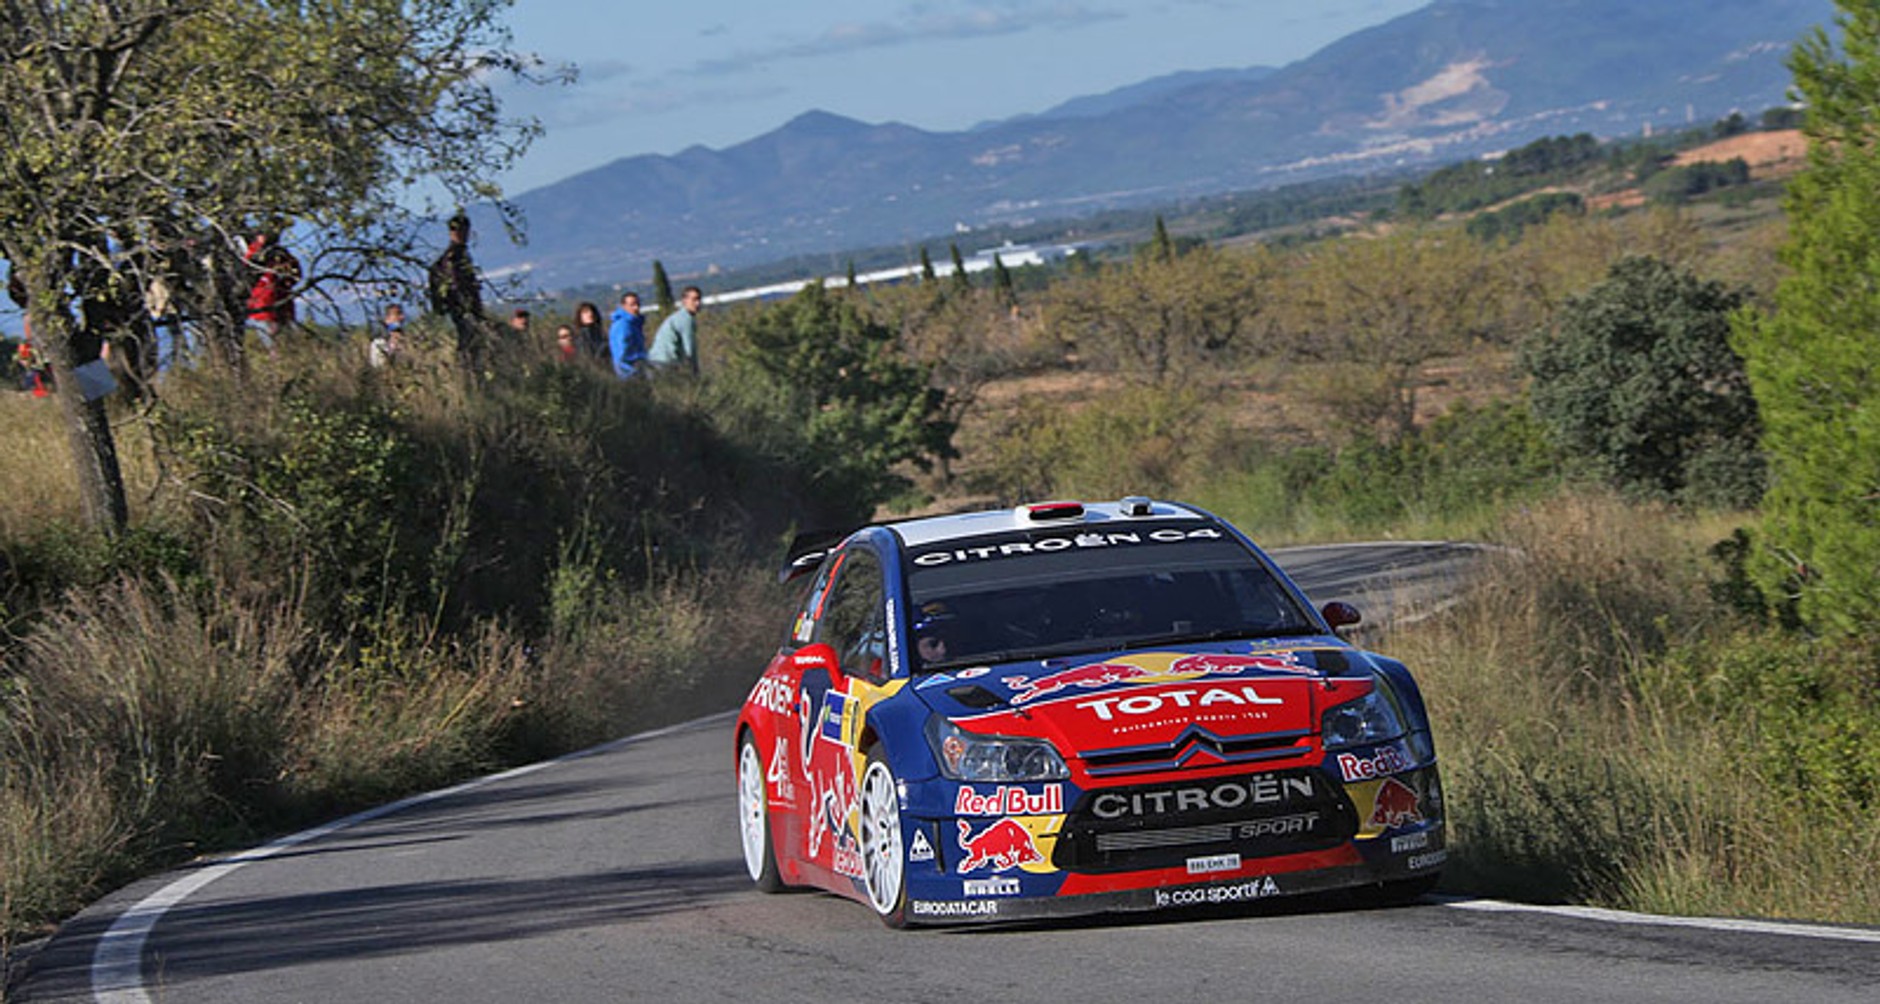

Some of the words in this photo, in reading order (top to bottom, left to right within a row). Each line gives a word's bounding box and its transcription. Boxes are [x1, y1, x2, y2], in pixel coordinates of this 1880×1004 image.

[914, 532, 1140, 566] CITROËN
[1149, 528, 1222, 542] C4
[1075, 686, 1284, 721] TOTAL
[1338, 747, 1390, 781] Red
[954, 786, 1005, 815] Red
[1006, 782, 1064, 814] Bull
[1092, 774, 1315, 818] CITROËN
[1238, 813, 1320, 839] SPORT
[913, 901, 998, 915] EURODATACAR
[1155, 889, 1170, 905] le
[1207, 878, 1261, 903] sportif
